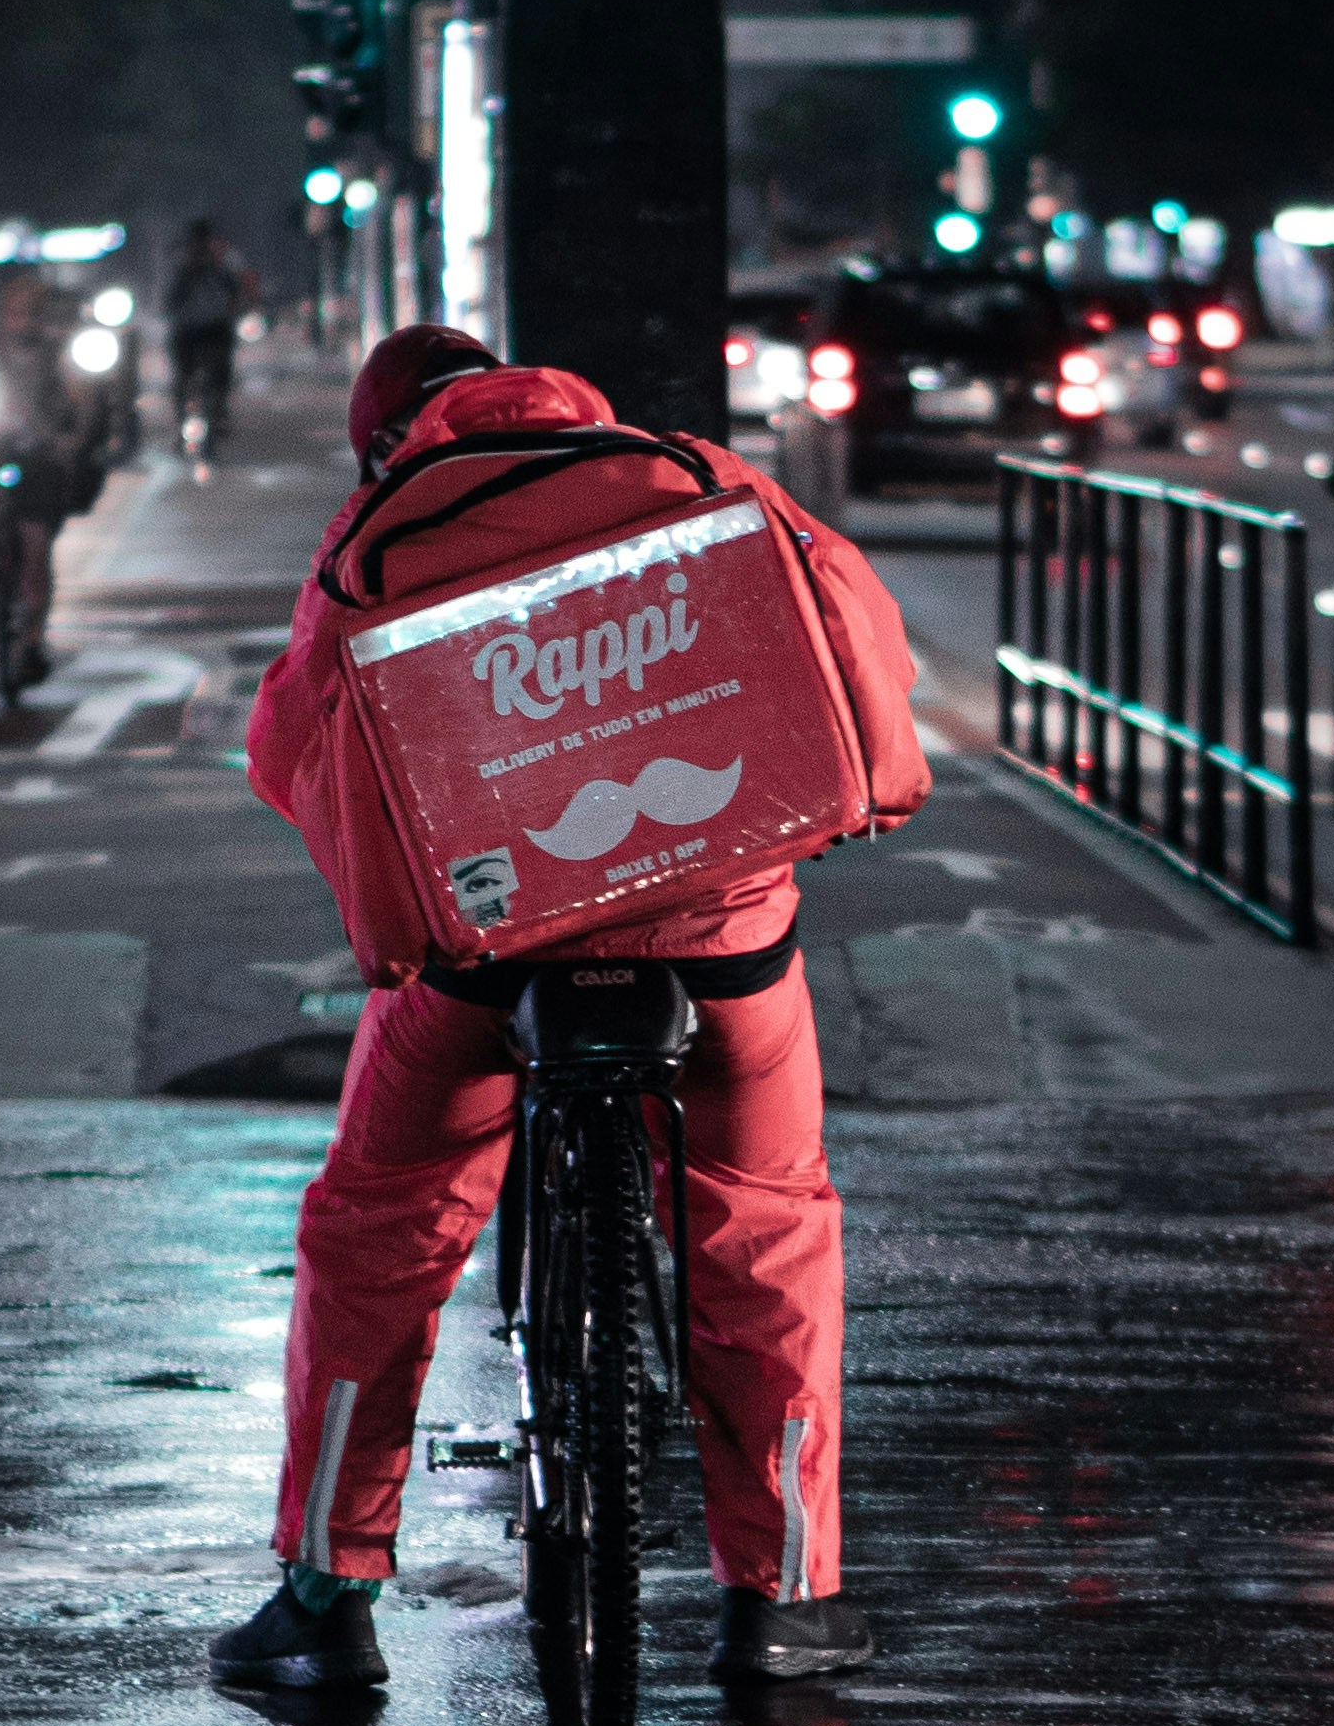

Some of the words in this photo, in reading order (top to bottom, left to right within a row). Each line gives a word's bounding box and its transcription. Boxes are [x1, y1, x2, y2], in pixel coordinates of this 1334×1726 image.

[473, 572, 700, 720] Rappi
[479, 741, 556, 778] DELIVERY
[562, 732, 584, 751] DE
[587, 715, 633, 741] TUDO
[636, 704, 663, 725] EM
[665, 678, 741, 715] MINUTOS
